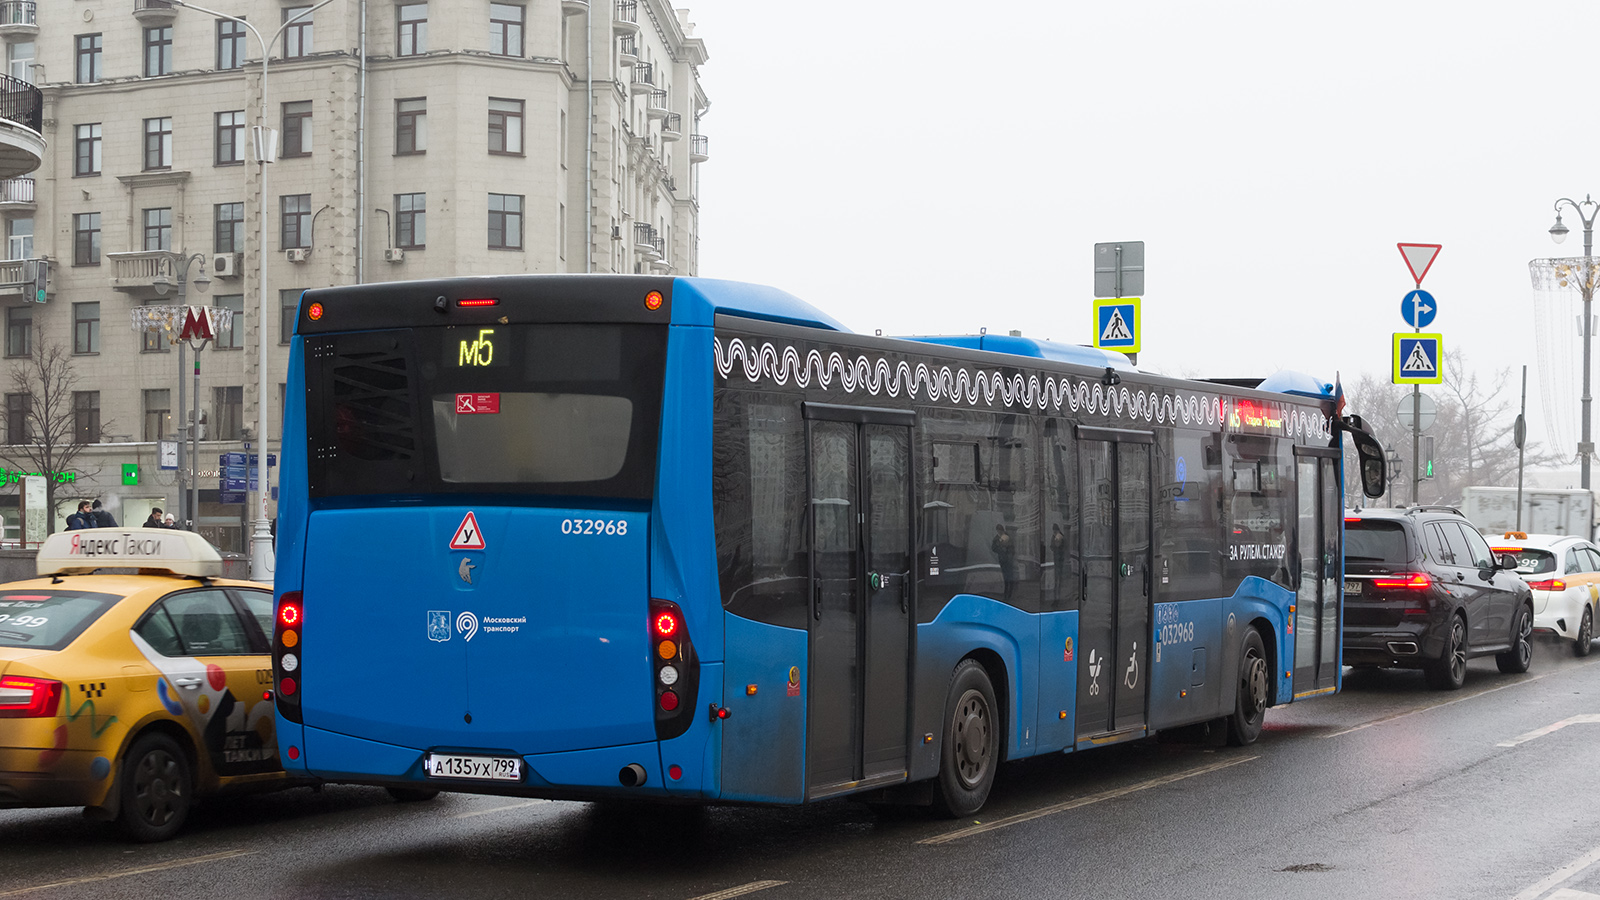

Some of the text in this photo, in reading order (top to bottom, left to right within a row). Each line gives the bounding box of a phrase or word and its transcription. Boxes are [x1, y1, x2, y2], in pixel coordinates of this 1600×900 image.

[561, 519, 628, 536] 032968
[69, 533, 162, 557] Яндекс Такси
[1229, 545, 1238, 560] ЗА
[1262, 544, 1286, 560] СТАЖЕР
[483, 616, 527, 624] Московский
[483, 626, 520, 634] транспорт
[1162, 621, 1194, 646] 032968
[435, 757, 515, 777] А135УХ 799
